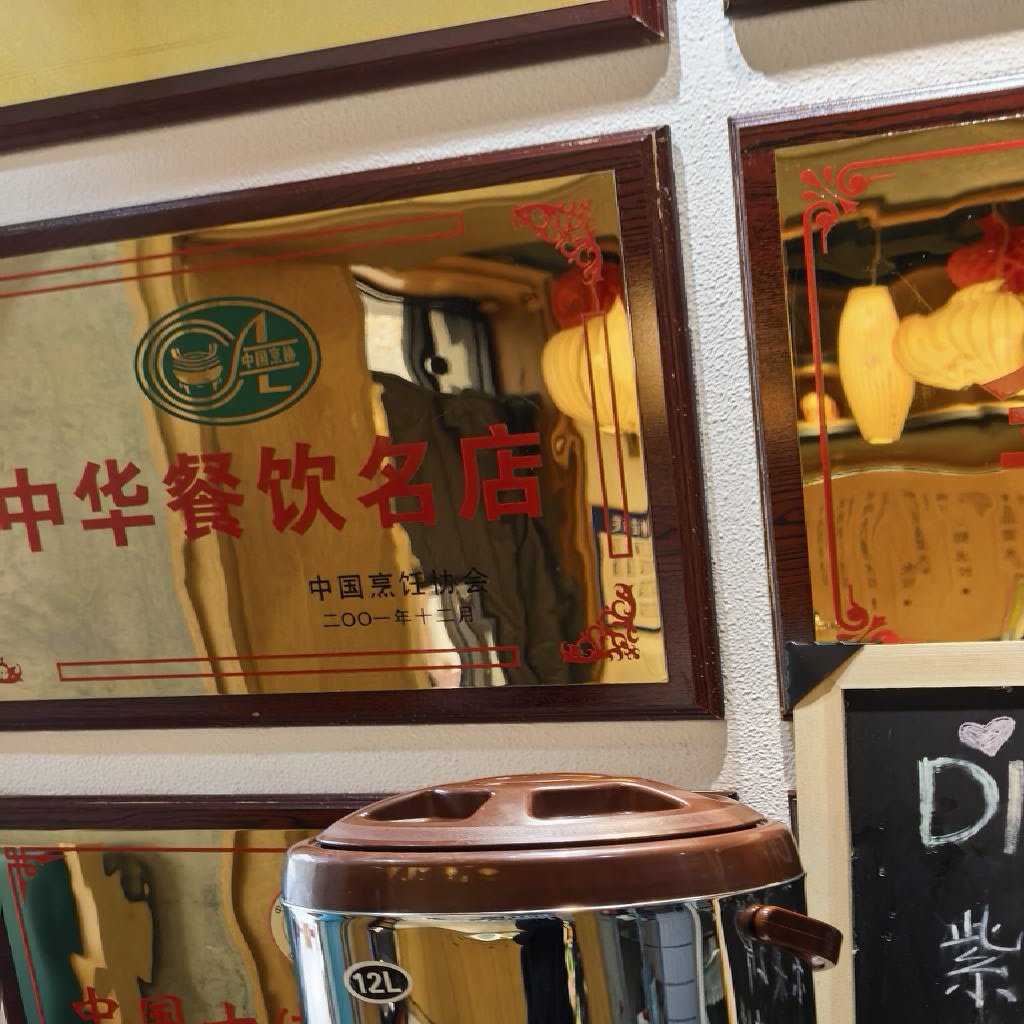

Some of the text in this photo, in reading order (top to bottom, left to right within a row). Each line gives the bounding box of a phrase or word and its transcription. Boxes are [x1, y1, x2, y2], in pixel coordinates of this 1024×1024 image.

[0, 424, 543, 553] 中华餐饮名店
[309, 567, 489, 602] 中国烹饪协会
[352, 971, 402, 994] 12L
